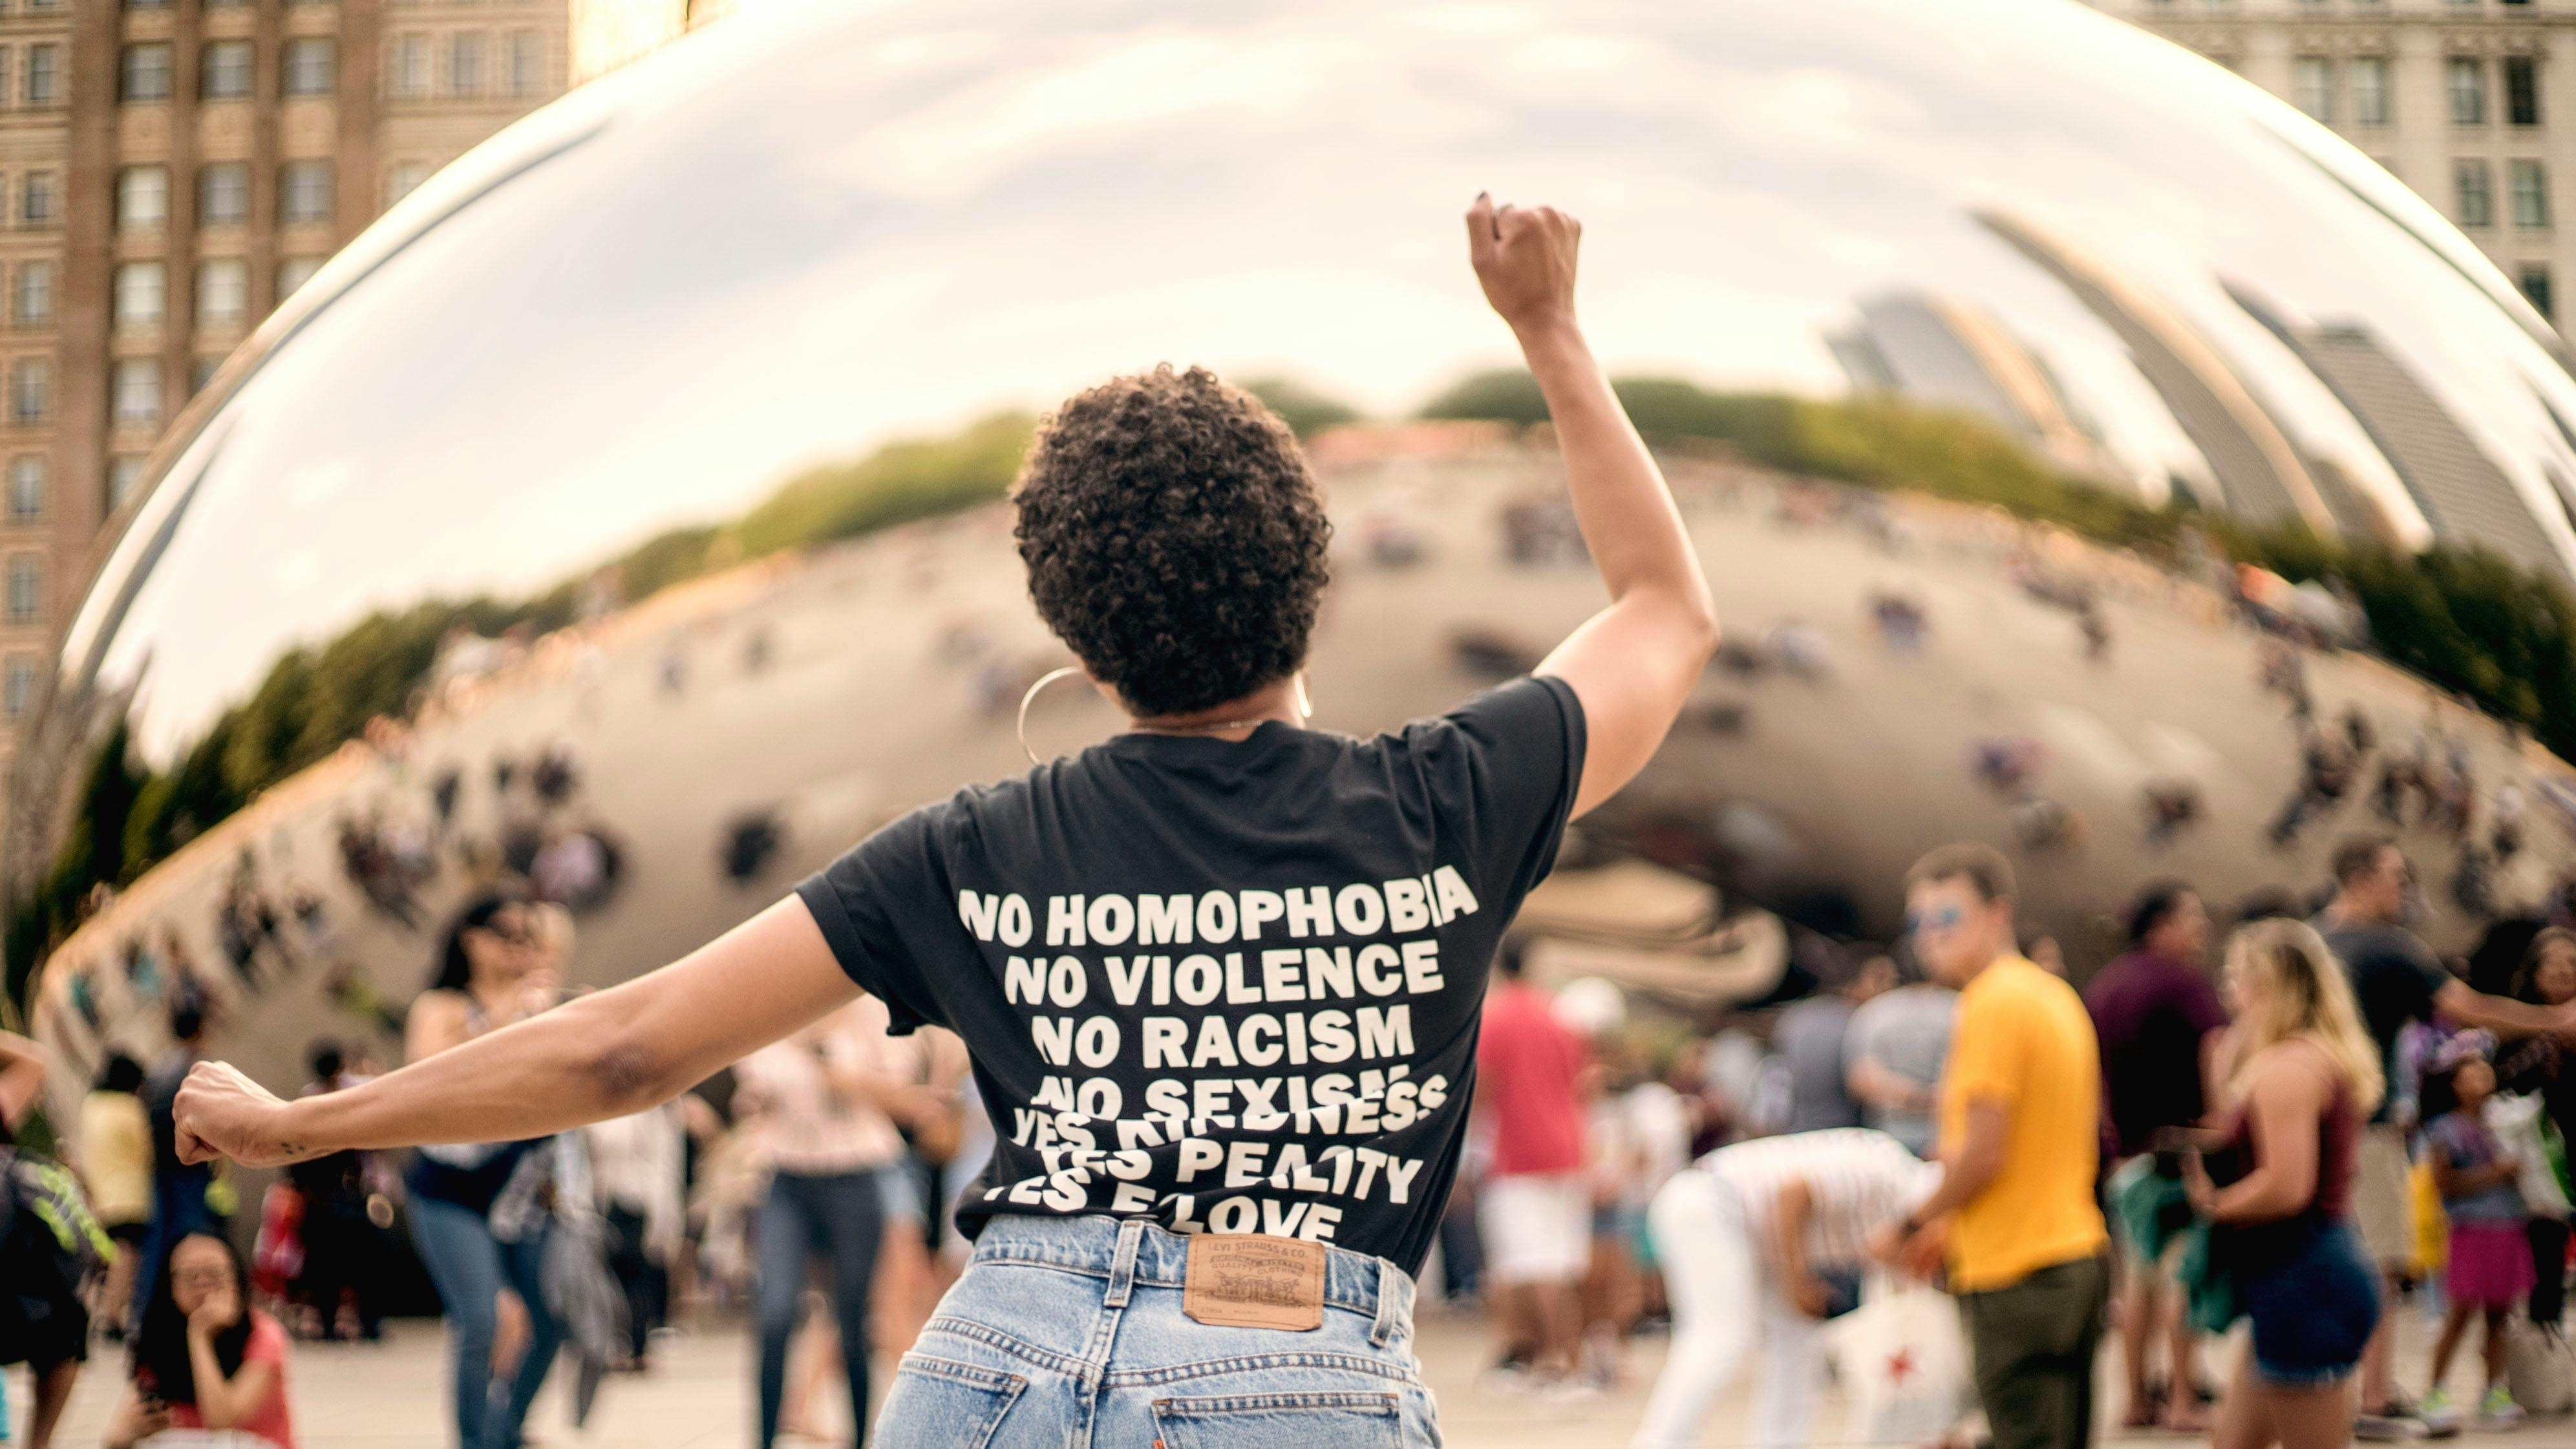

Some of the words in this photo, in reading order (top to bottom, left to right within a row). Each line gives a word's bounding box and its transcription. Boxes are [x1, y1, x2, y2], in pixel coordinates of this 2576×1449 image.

[959, 889, 1032, 947] NO
[1047, 865, 1479, 947] HOMOPHOBIA
[1005, 955, 1087, 1008] NO
[1103, 940, 1444, 1006] VIOLENCE
[1031, 1015, 1121, 1068] NO
[1142, 1004, 1415, 1068] RACISM
[1030, 1075, 1123, 1121] NO
[1008, 1108, 1096, 1152] YES
[983, 1167, 1088, 1212] ES
[1170, 1195, 1343, 1247] LOVE
[1208, 1242, 1231, 1251] LEVI
[1235, 1242, 1280, 1256] STRAUSS
